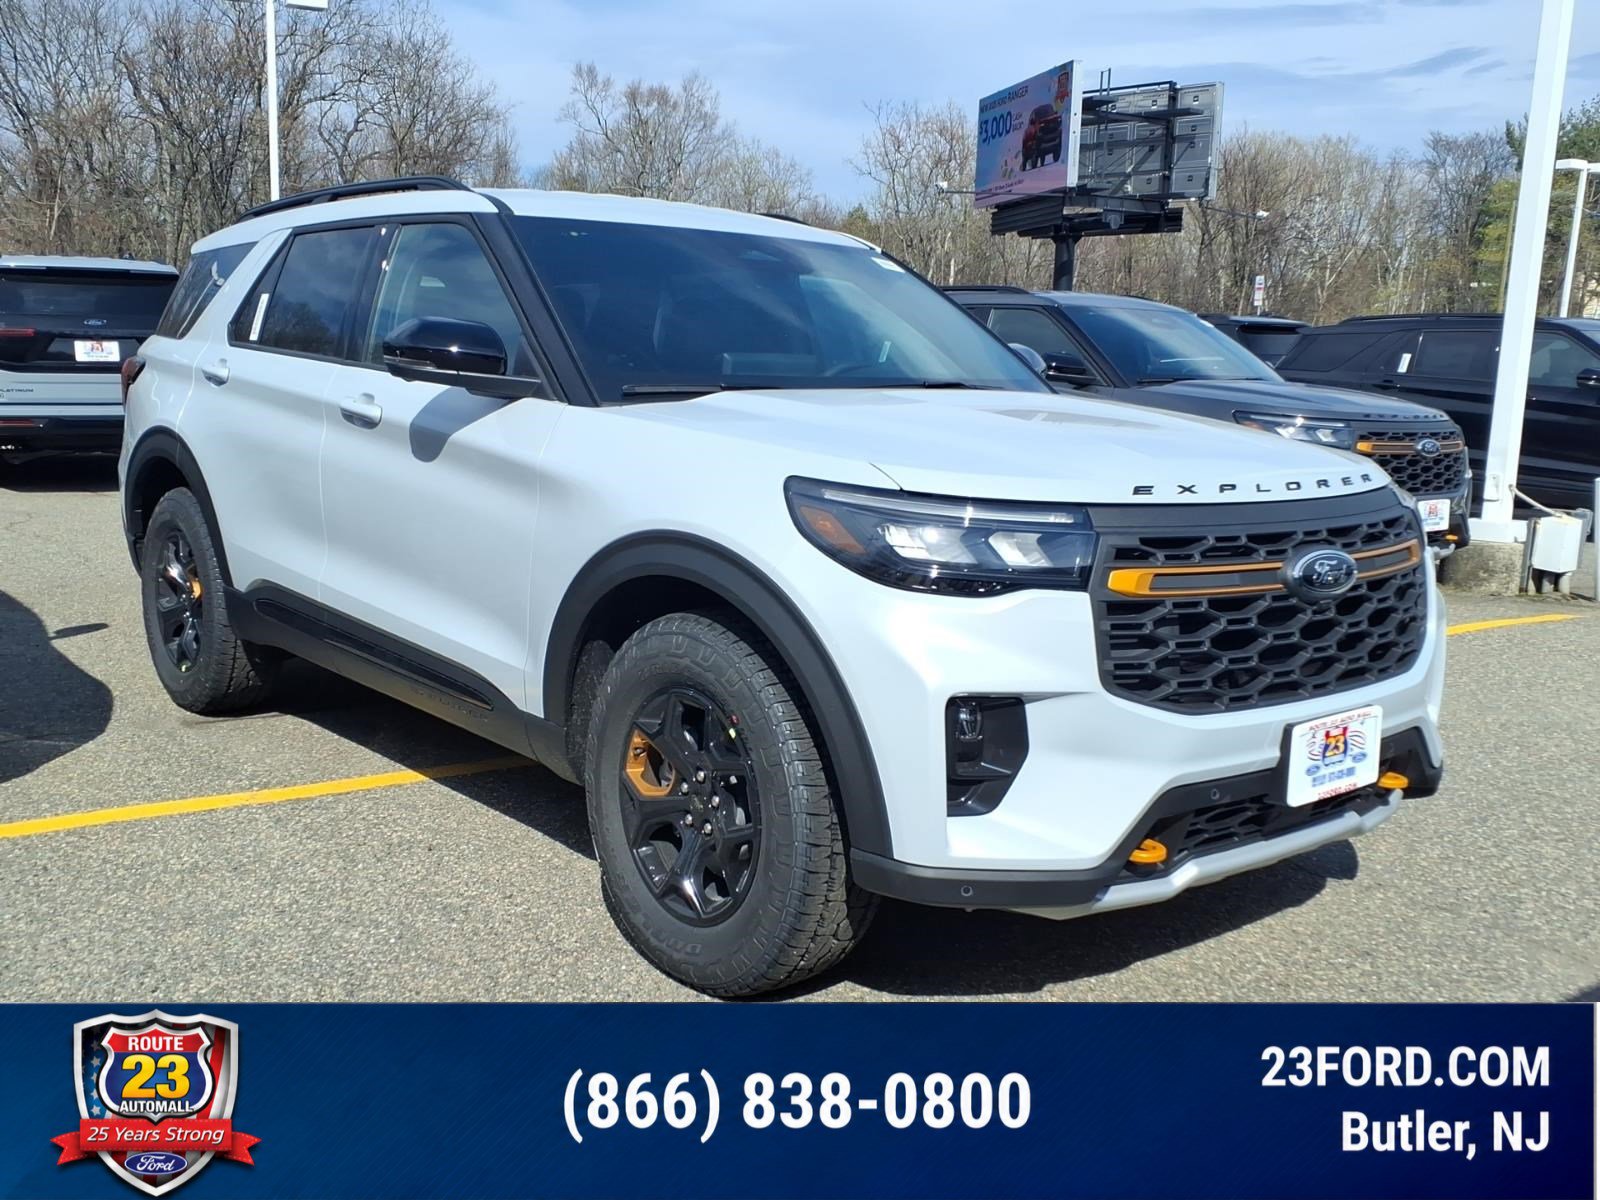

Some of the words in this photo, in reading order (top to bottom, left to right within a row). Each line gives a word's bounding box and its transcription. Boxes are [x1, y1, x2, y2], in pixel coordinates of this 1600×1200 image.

[1007, 85, 1029, 103] RANGER
[979, 111, 1012, 144] $3,000
[1132, 473, 1373, 495] EXPLORER
[1312, 559, 1347, 586] Ford
[1325, 735, 1345, 758] 23
